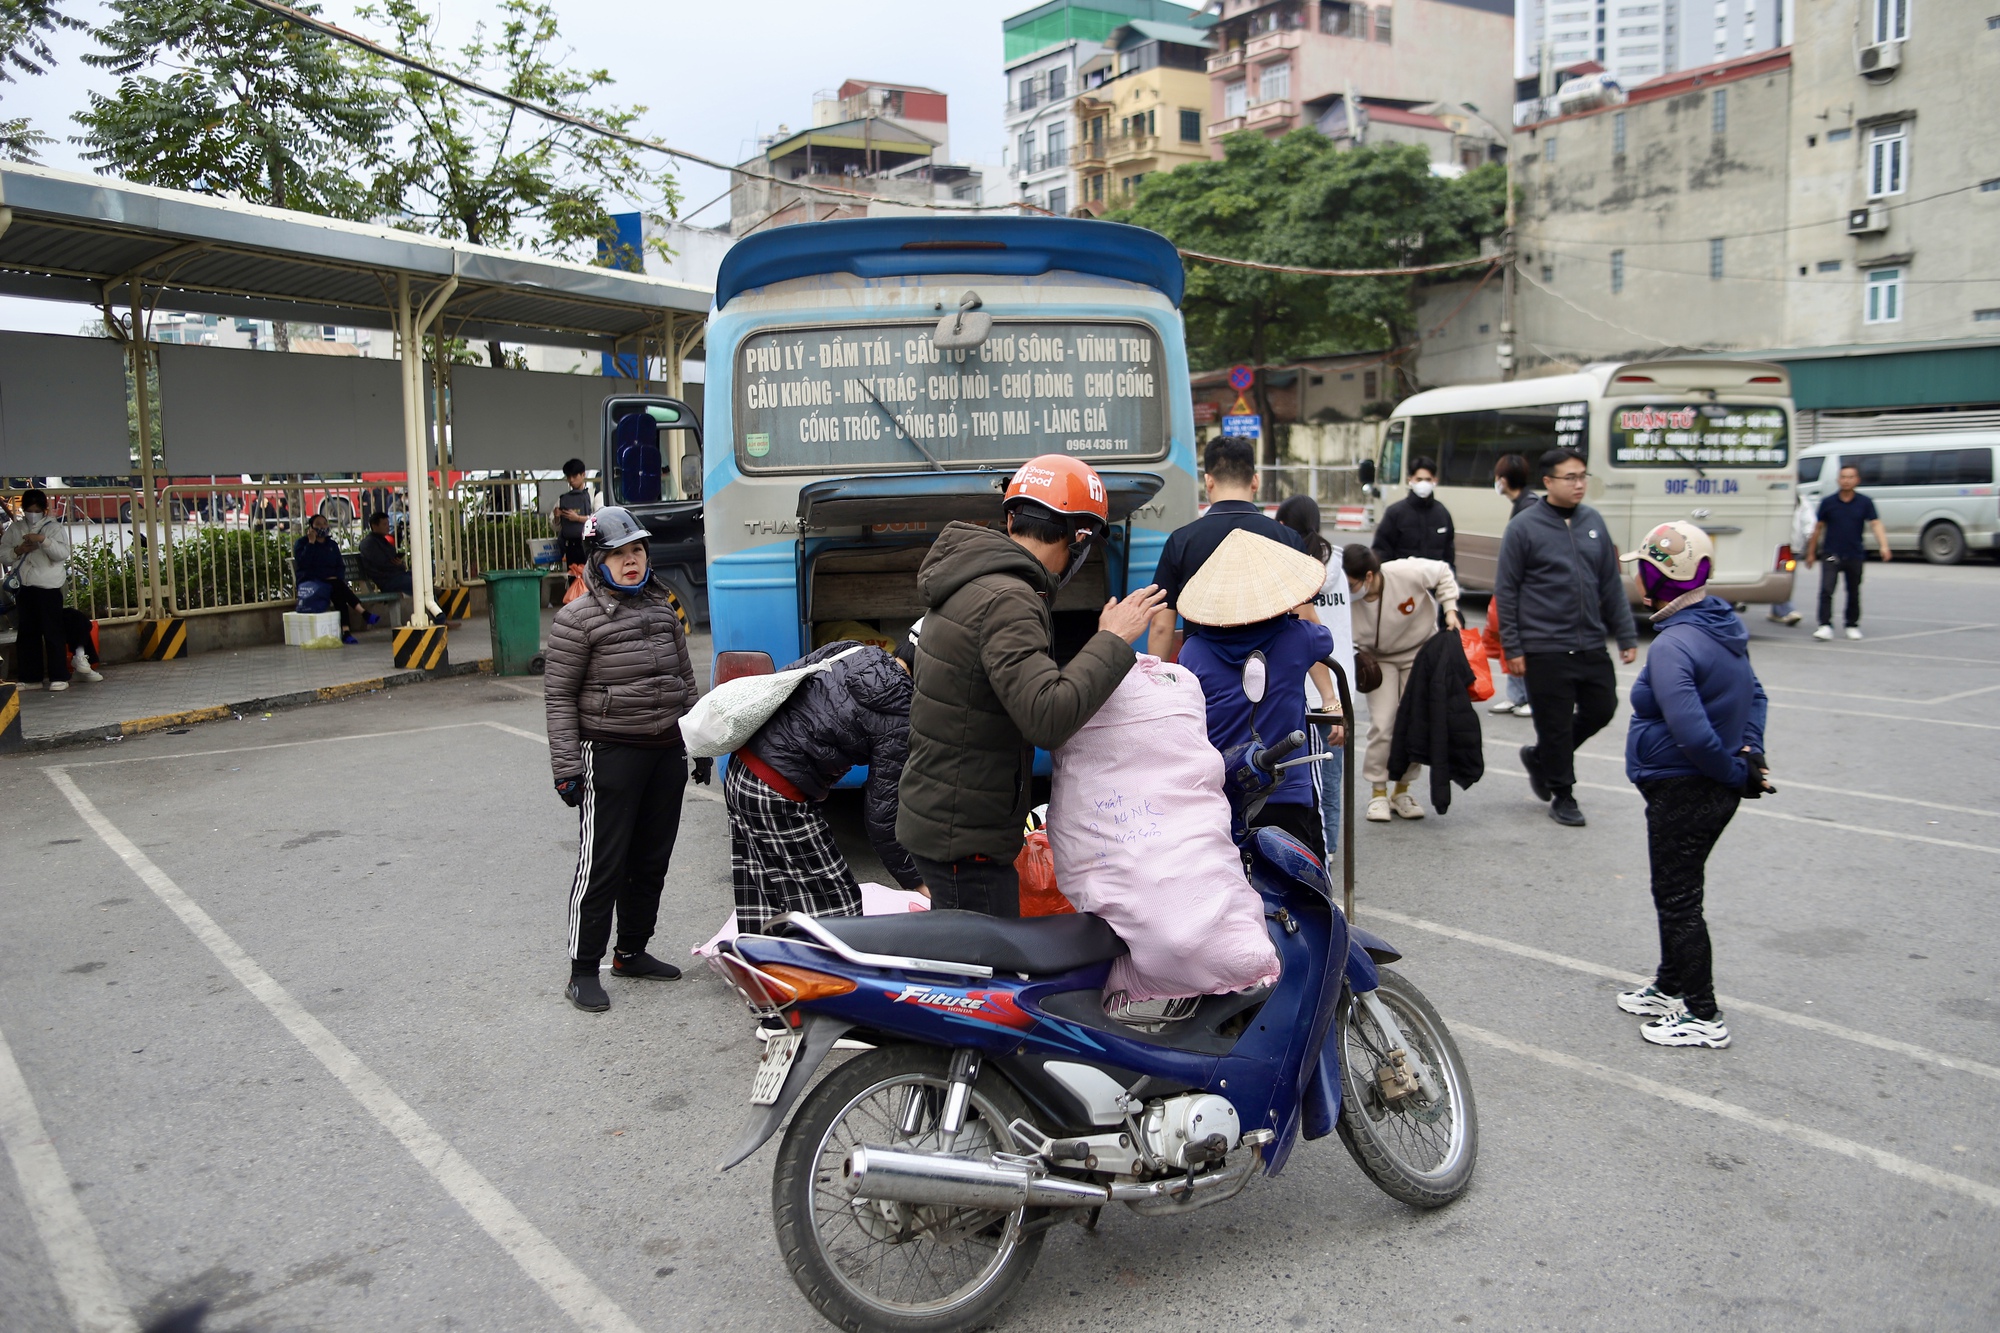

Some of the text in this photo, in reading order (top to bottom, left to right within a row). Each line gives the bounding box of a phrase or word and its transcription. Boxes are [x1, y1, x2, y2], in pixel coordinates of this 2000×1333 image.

[746, 340, 781, 373] PHỦ
[785, 340, 804, 371] LÝ
[819, 335, 860, 368] ĐẦM
[862, 336, 891, 366] TÁI
[905, 332, 941, 364] CẦU
[980, 334, 1015, 367] CHỢ
[1018, 333, 1064, 363] SÔNG
[1076, 334, 1116, 362] VĨNH
[1119, 338, 1151, 367] TRỤ
[747, 376, 778, 410] CẦU
[781, 376, 832, 407] KHÔNG
[843, 374, 876, 404] NHƯ
[877, 372, 917, 402] TRÁC
[928, 372, 959, 405] CHỢ
[962, 370, 990, 399] MÒI
[1002, 370, 1032, 403] CHỢ
[1034, 368, 1073, 398] ĐÒNG
[1085, 369, 1113, 402] CHỢ
[1116, 366, 1154, 398] CỐNG
[799, 410, 839, 443] CỐNG
[843, 410, 881, 441] TRÓC
[895, 406, 934, 440] CỐNG
[938, 405, 958, 438] ĐỎ
[971, 412, 998, 441] THỌ
[1002, 411, 1030, 435] MAI
[1043, 404, 1080, 434] LÀNG
[1084, 403, 1108, 432] GIÁ
[1066, 439, 1128, 451] 0964 436 111
[1027, 465, 1055, 477] Shopee
[1024, 474, 1053, 488] Food
[1665, 479, 1738, 494] 90F-001.04
[947, 1006, 973, 1014] HONDA
